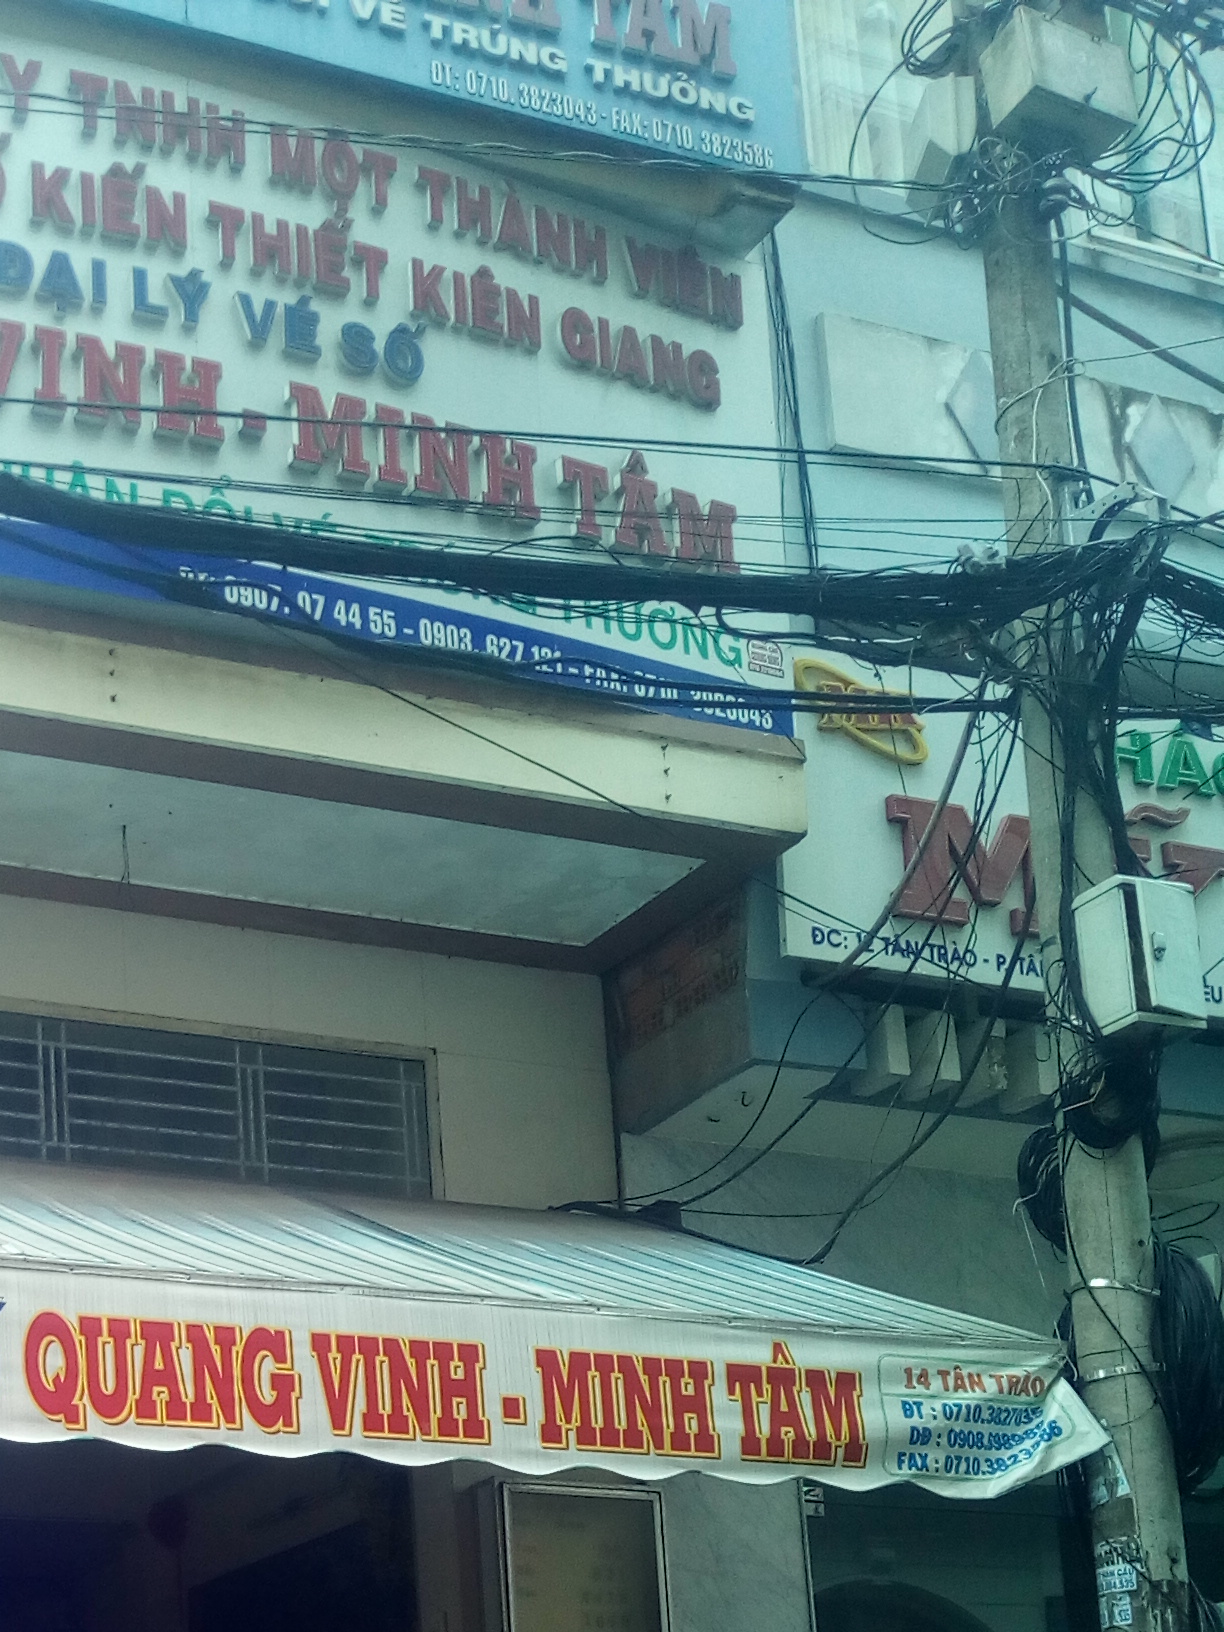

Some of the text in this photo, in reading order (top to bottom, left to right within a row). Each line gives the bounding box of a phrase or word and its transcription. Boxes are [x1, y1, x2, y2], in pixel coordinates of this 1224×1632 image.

[424, 12, 568, 73] TRÚNG
[701, 130, 774, 170] 3823586
[68, 68, 246, 172] TNHH
[270, 122, 397, 216] MỘT
[417, 165, 609, 284] THÀNH
[624, 236, 743, 330] VIÊN
[30, 160, 187, 256] KIẾN
[206, 199, 388, 304] THIẾT
[411, 256, 542, 353] KIÊN
[559, 306, 721, 413] GIANG
[132, 267, 211, 330] LÝ
[235, 291, 321, 360] VÉ
[339, 321, 426, 387] SỐ
[286, 381, 540, 526] MINH
[556, 449, 741, 574] TÂM
[334, 599, 362, 631] 44
[369, 607, 396, 638] 55
[811, 926, 848, 949] ĐC:
[882, 935, 921, 959] TÂN
[927, 941, 977, 968] TRÀO
[1017, 953, 1045, 977] TÂ
[22, 1308, 301, 1434] QUANG
[309, 1330, 492, 1446] VINH
[533, 1346, 721, 1459] MINH
[725, 1339, 868, 1469] TÂM
[903, 1365, 1047, 1398] 14 TÂN TRÀO
[897, 1452, 930, 1472] FAX
